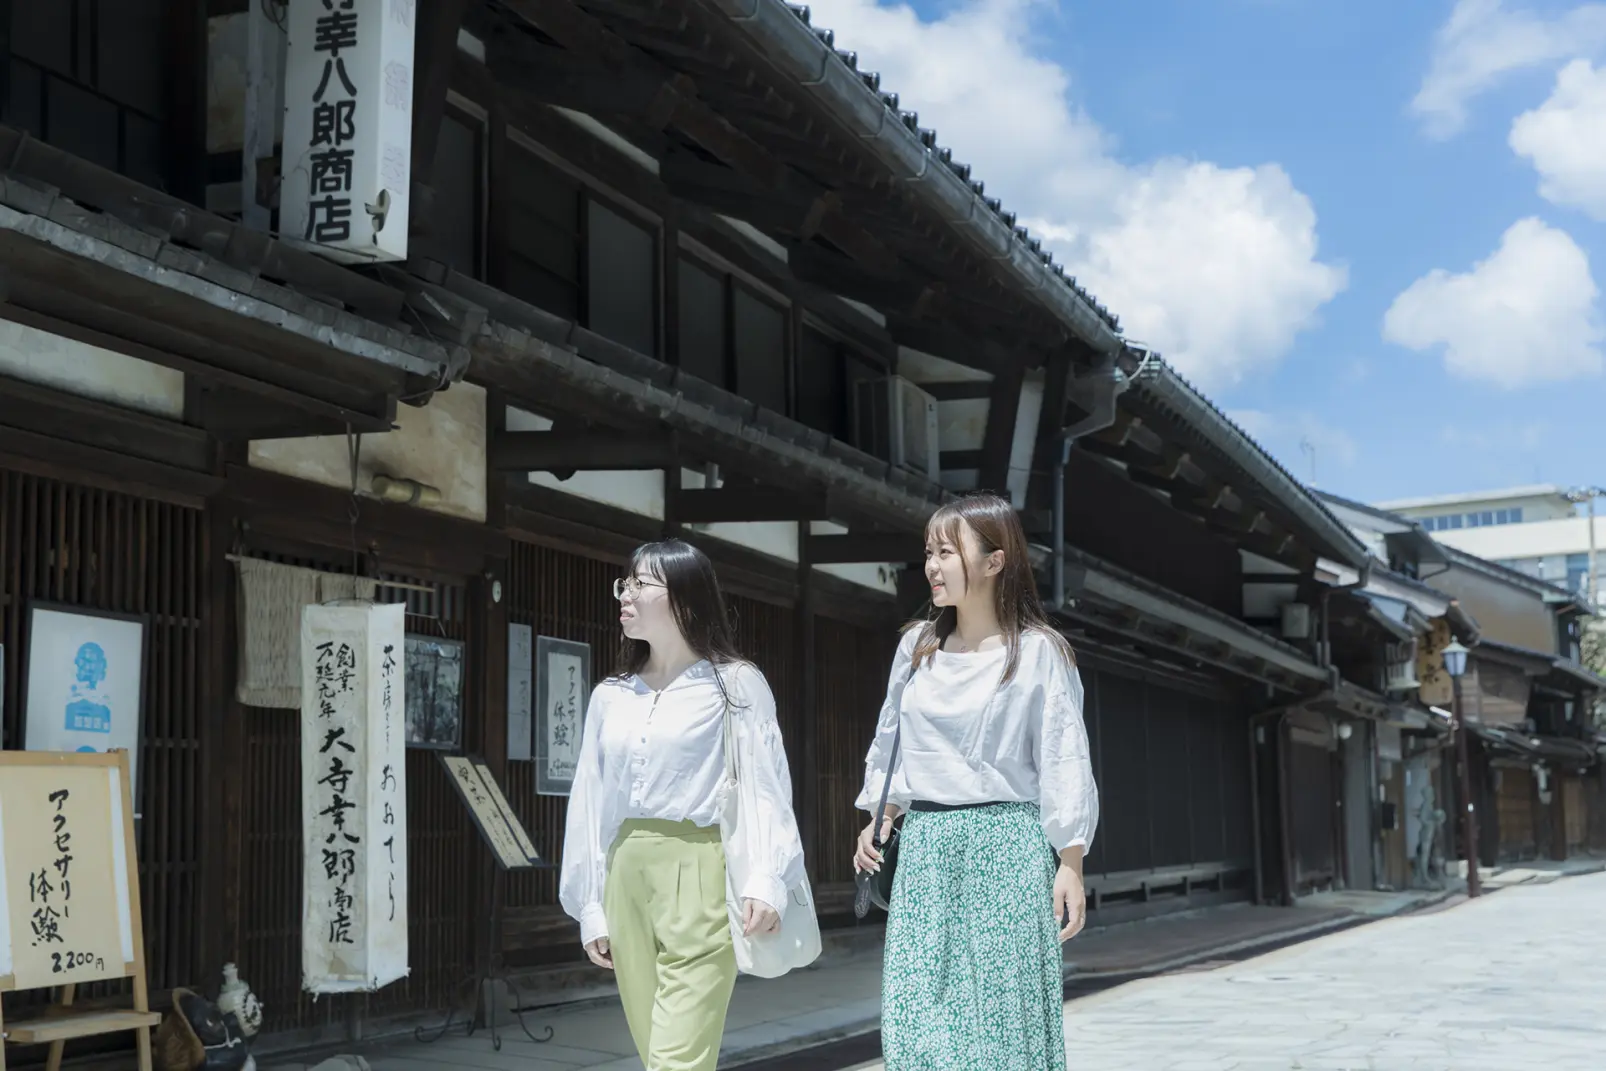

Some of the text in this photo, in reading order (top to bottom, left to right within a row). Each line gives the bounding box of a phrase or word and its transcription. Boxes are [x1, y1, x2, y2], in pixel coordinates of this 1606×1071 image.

[305, 0, 357, 242] 幸八郎商店
[315, 641, 337, 719] 万延元年
[335, 643, 356, 693] 創業
[48, 788, 73, 918] アクセサリー
[317, 727, 359, 944] 大寺幸八郎商店
[29, 867, 64, 946] 体験
